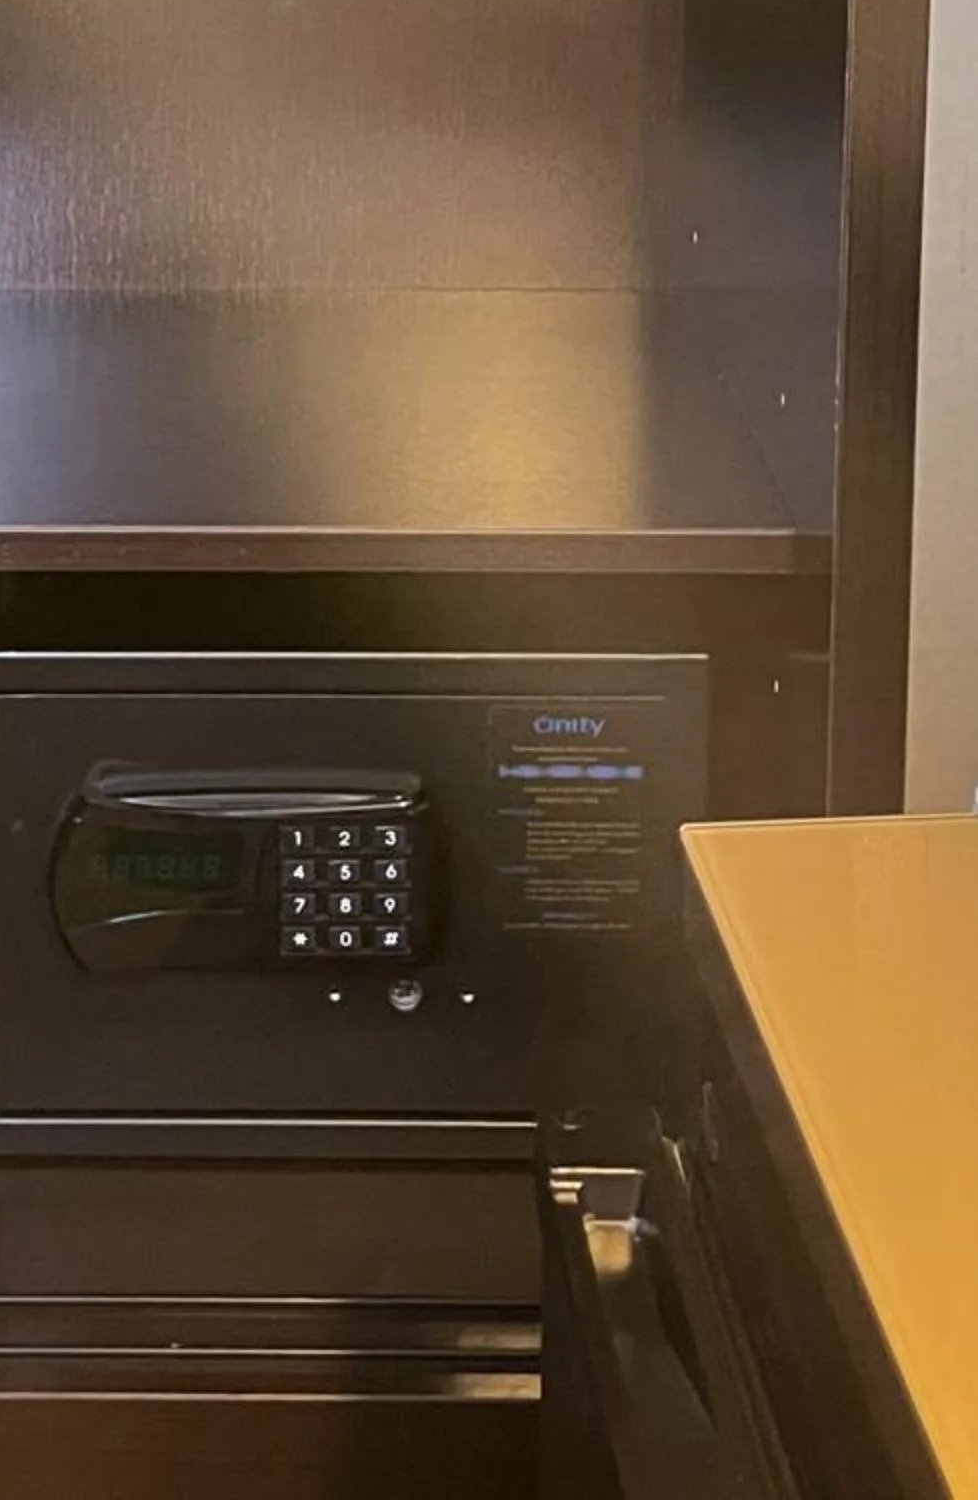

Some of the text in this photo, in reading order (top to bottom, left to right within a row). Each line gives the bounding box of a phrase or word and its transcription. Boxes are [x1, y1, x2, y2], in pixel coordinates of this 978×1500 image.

[294, 830, 397, 846] 1 2 3
[293, 864, 398, 880] 4 5 6
[293, 897, 396, 913] 7 8 9
[339, 931, 352, 947] 0
